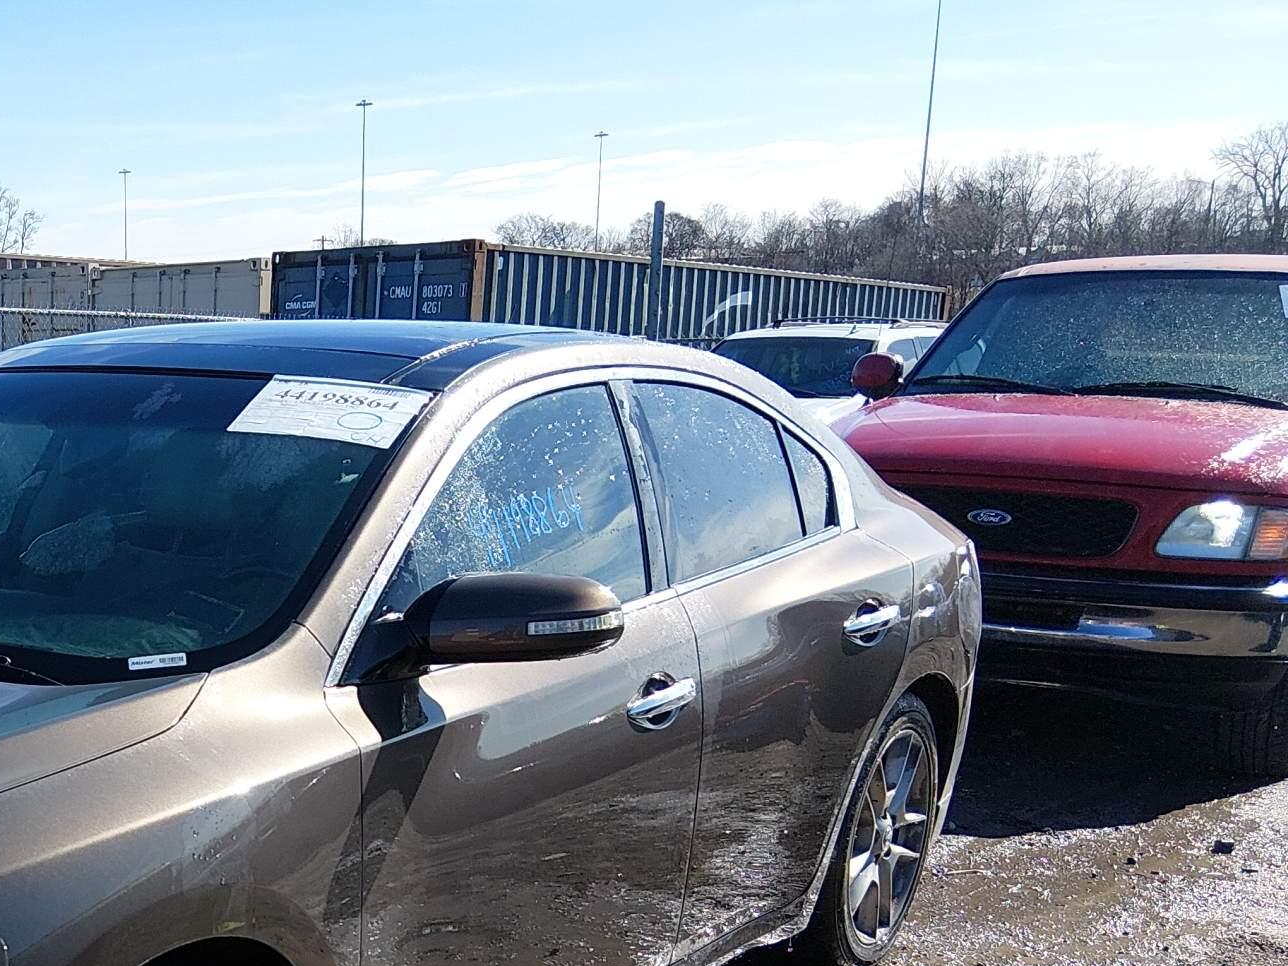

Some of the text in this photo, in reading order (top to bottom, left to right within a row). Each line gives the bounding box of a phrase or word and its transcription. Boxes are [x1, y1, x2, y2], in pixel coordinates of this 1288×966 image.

[389, 283, 412, 299] CMAU
[421, 284, 453, 298] 803073
[285, 301, 301, 310] CMA
[421, 300, 442, 313] 42G1
[273, 388, 400, 411] 44198864
